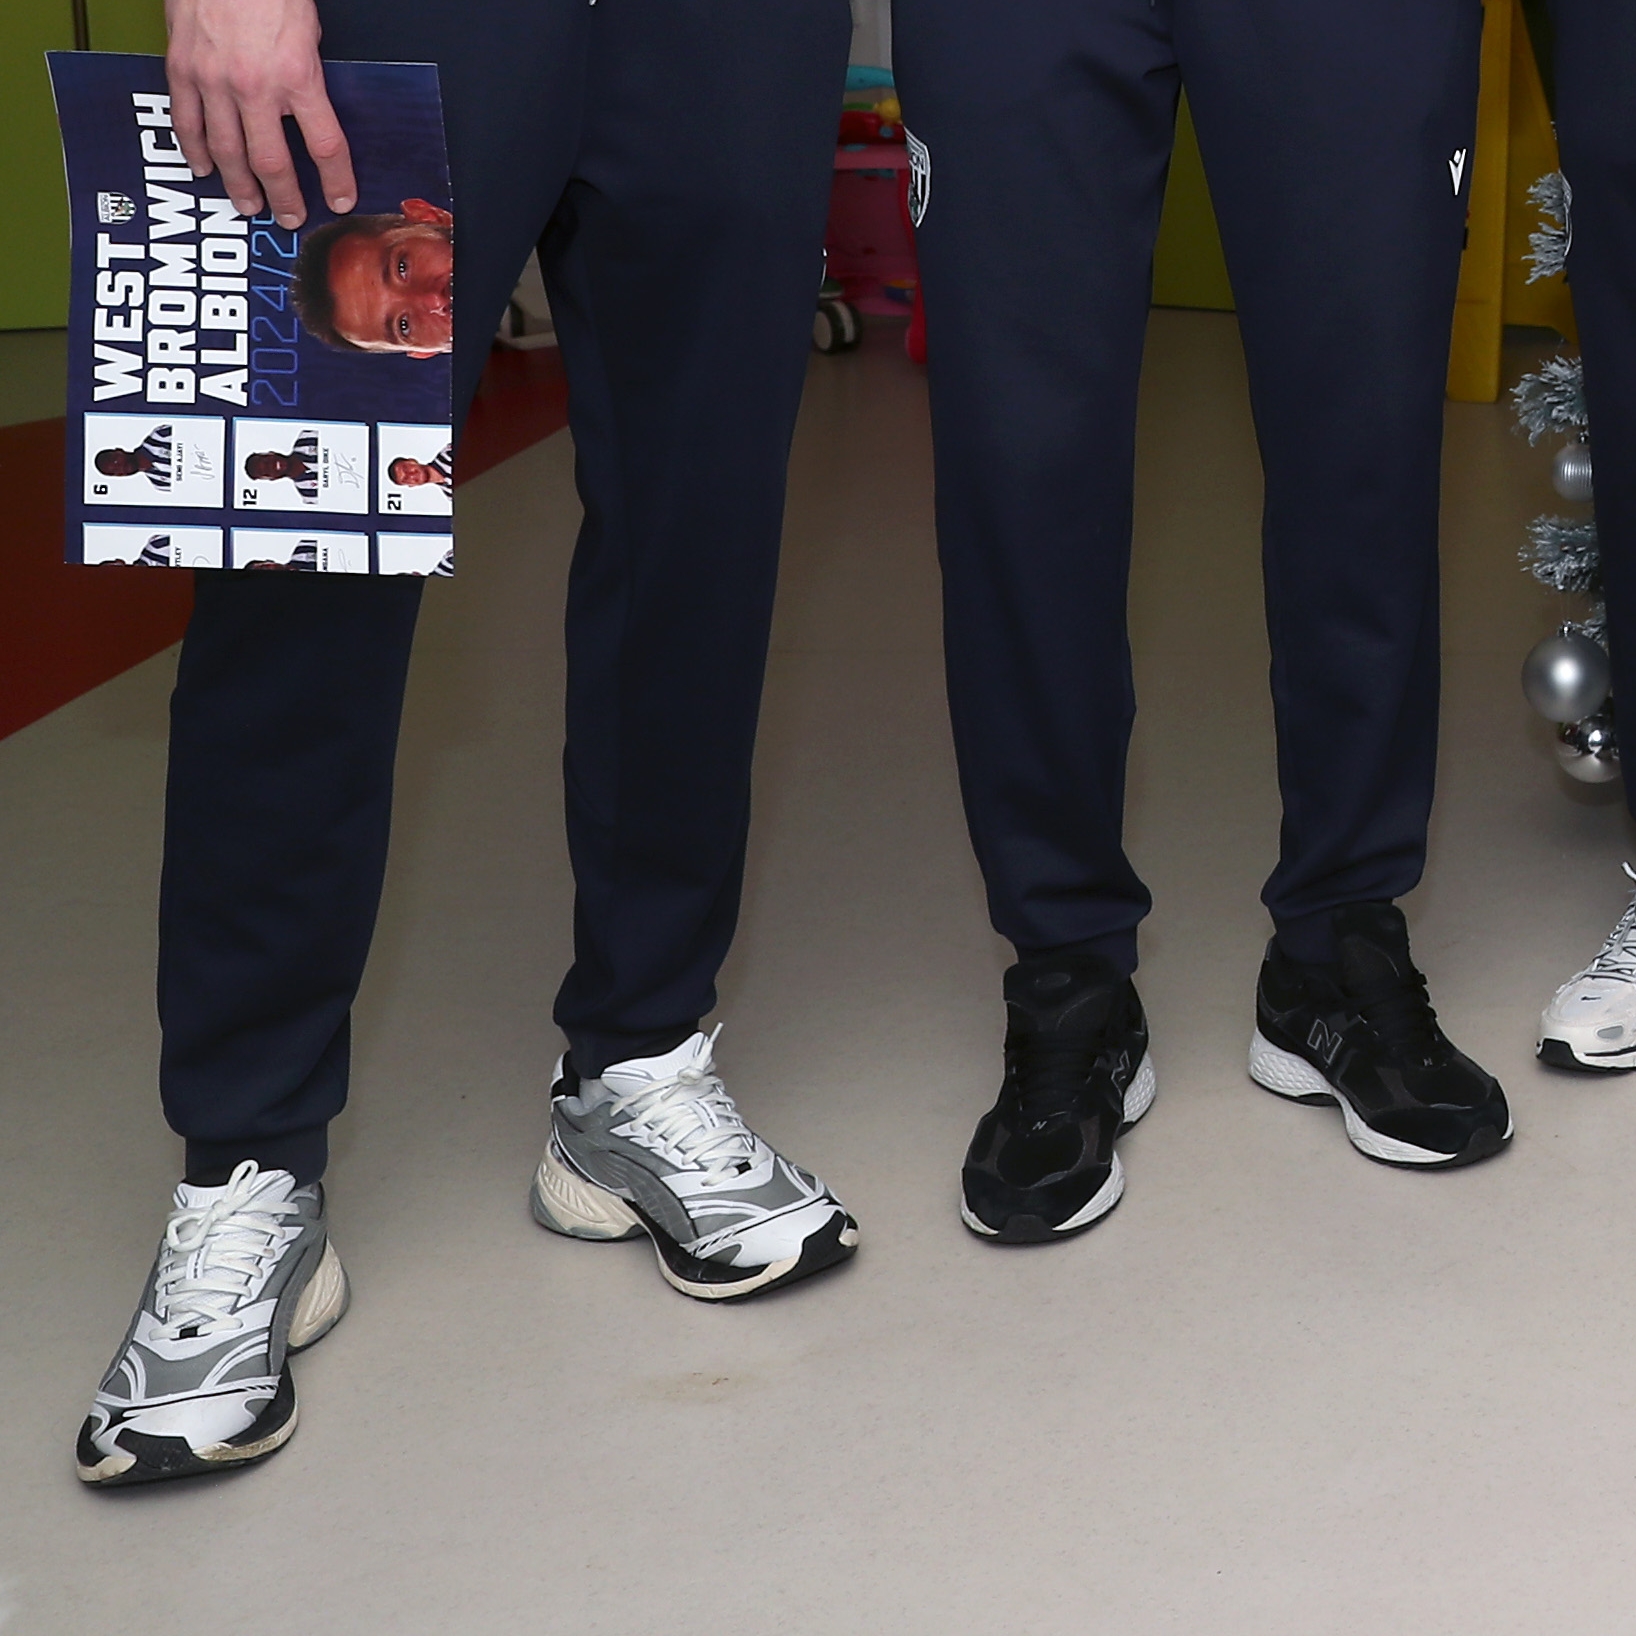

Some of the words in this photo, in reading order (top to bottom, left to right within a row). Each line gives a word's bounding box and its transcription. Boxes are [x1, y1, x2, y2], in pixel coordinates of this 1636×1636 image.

[93, 232, 146, 402] WEST
[132, 92, 197, 404] BROMWICH
[200, 197, 249, 407] ALBION
[251, 214, 299, 407] 2024/2
[93, 484, 109, 496] 6
[243, 488, 257, 507] 12
[387, 492, 402, 511] 21
